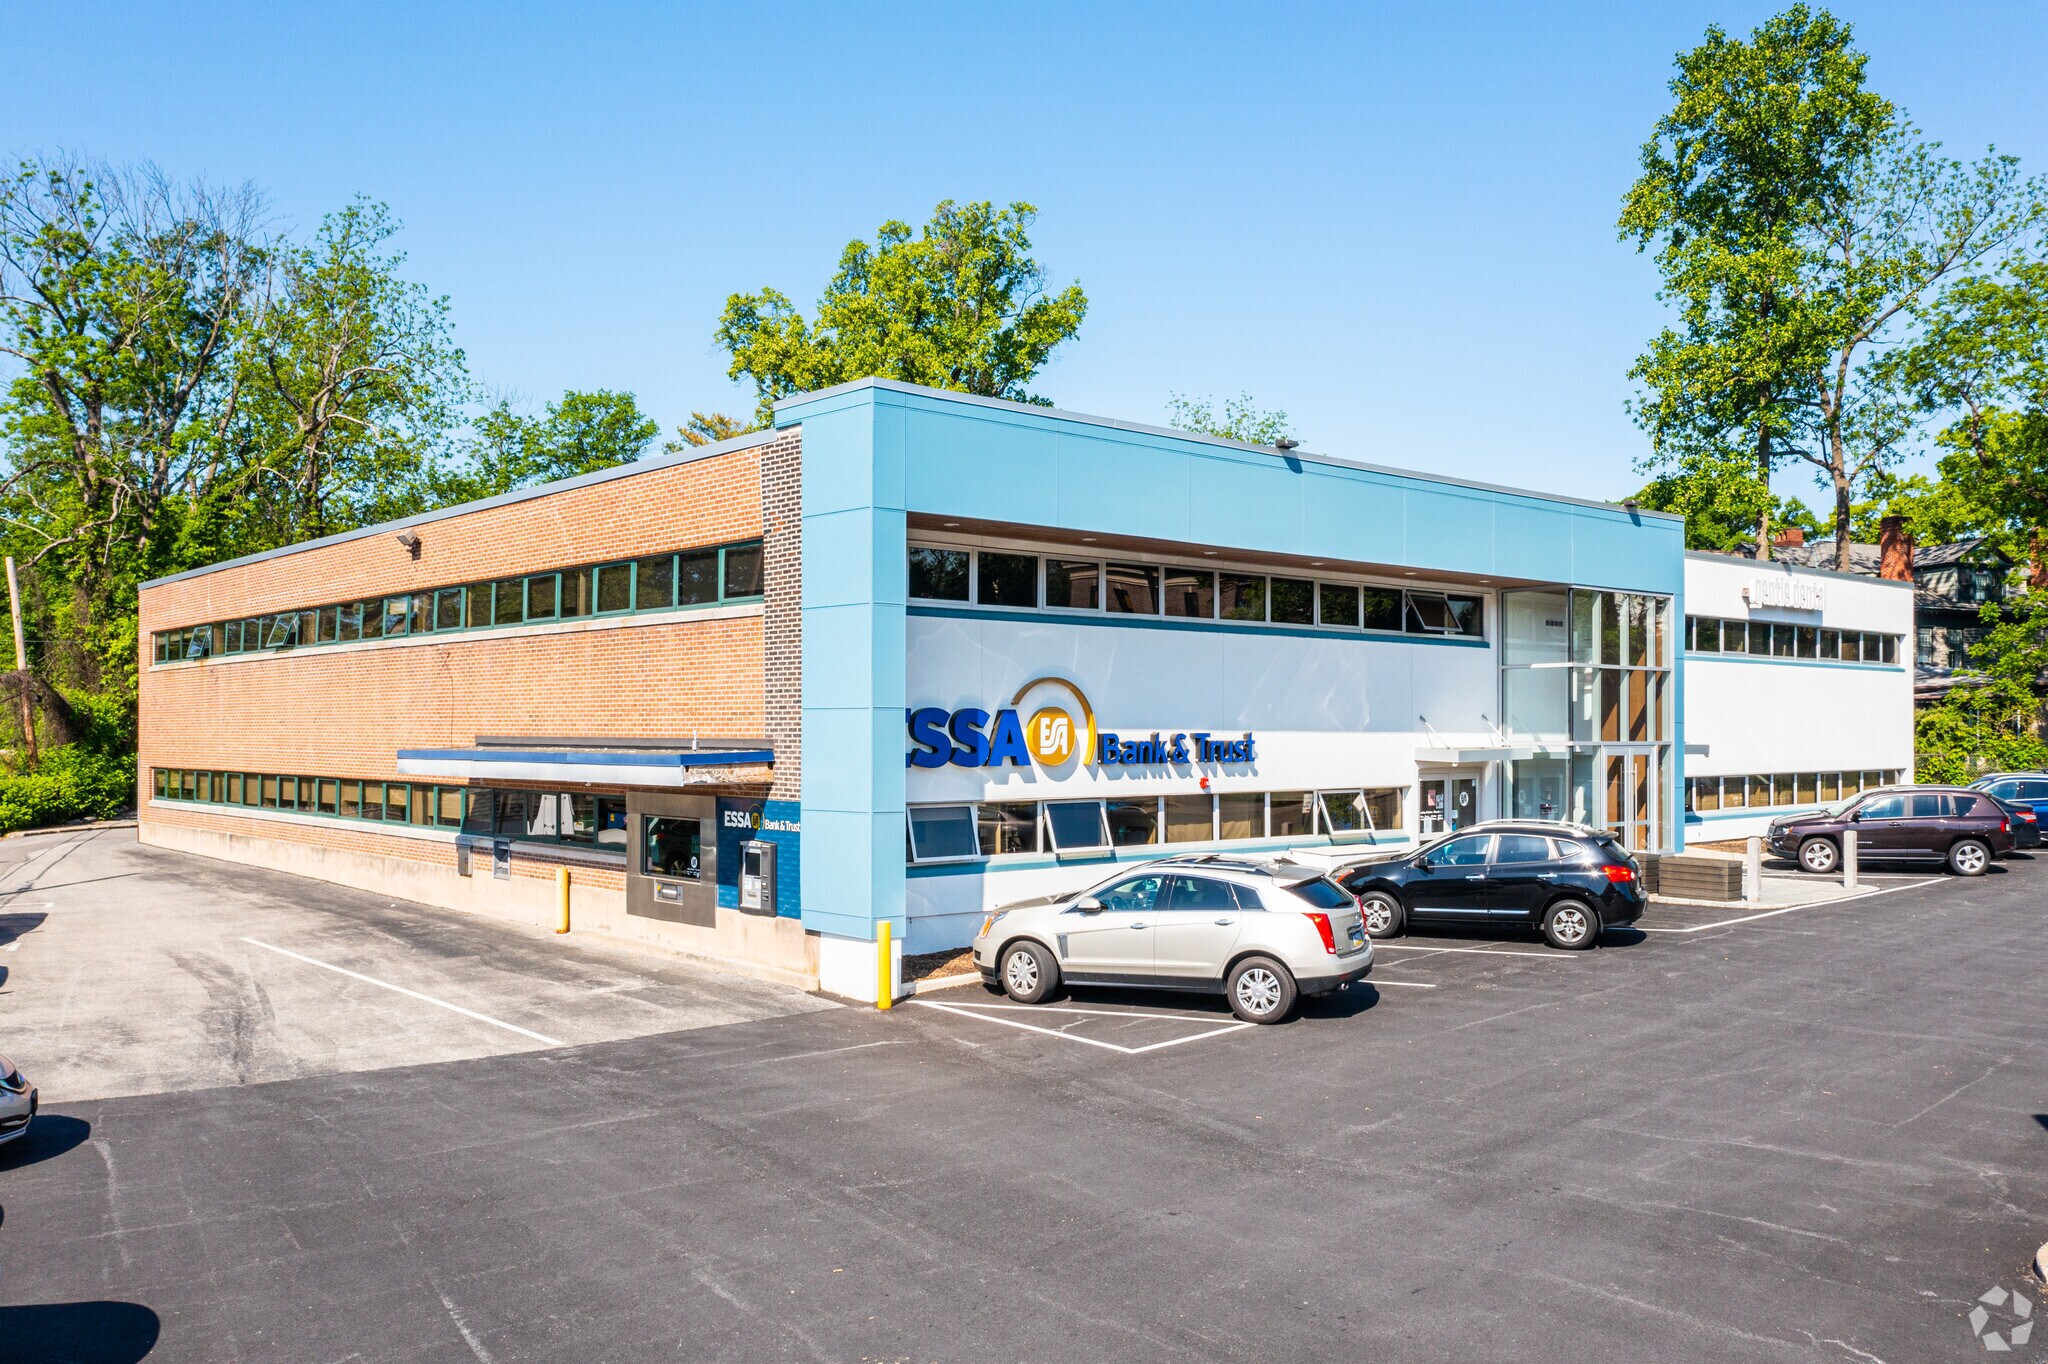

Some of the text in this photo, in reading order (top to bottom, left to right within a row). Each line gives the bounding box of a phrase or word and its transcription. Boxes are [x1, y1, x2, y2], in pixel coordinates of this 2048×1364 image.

[1793, 579, 1827, 610] dental
[905, 707, 1032, 769] SSA
[1098, 732, 1168, 765] Bank
[1168, 733, 1190, 764] &
[1193, 731, 1256, 764] Trust
[724, 810, 752, 829] ESSA
[765, 819, 779, 830] Bank
[780, 819, 786, 831] &
[785, 820, 801, 832] Trust
